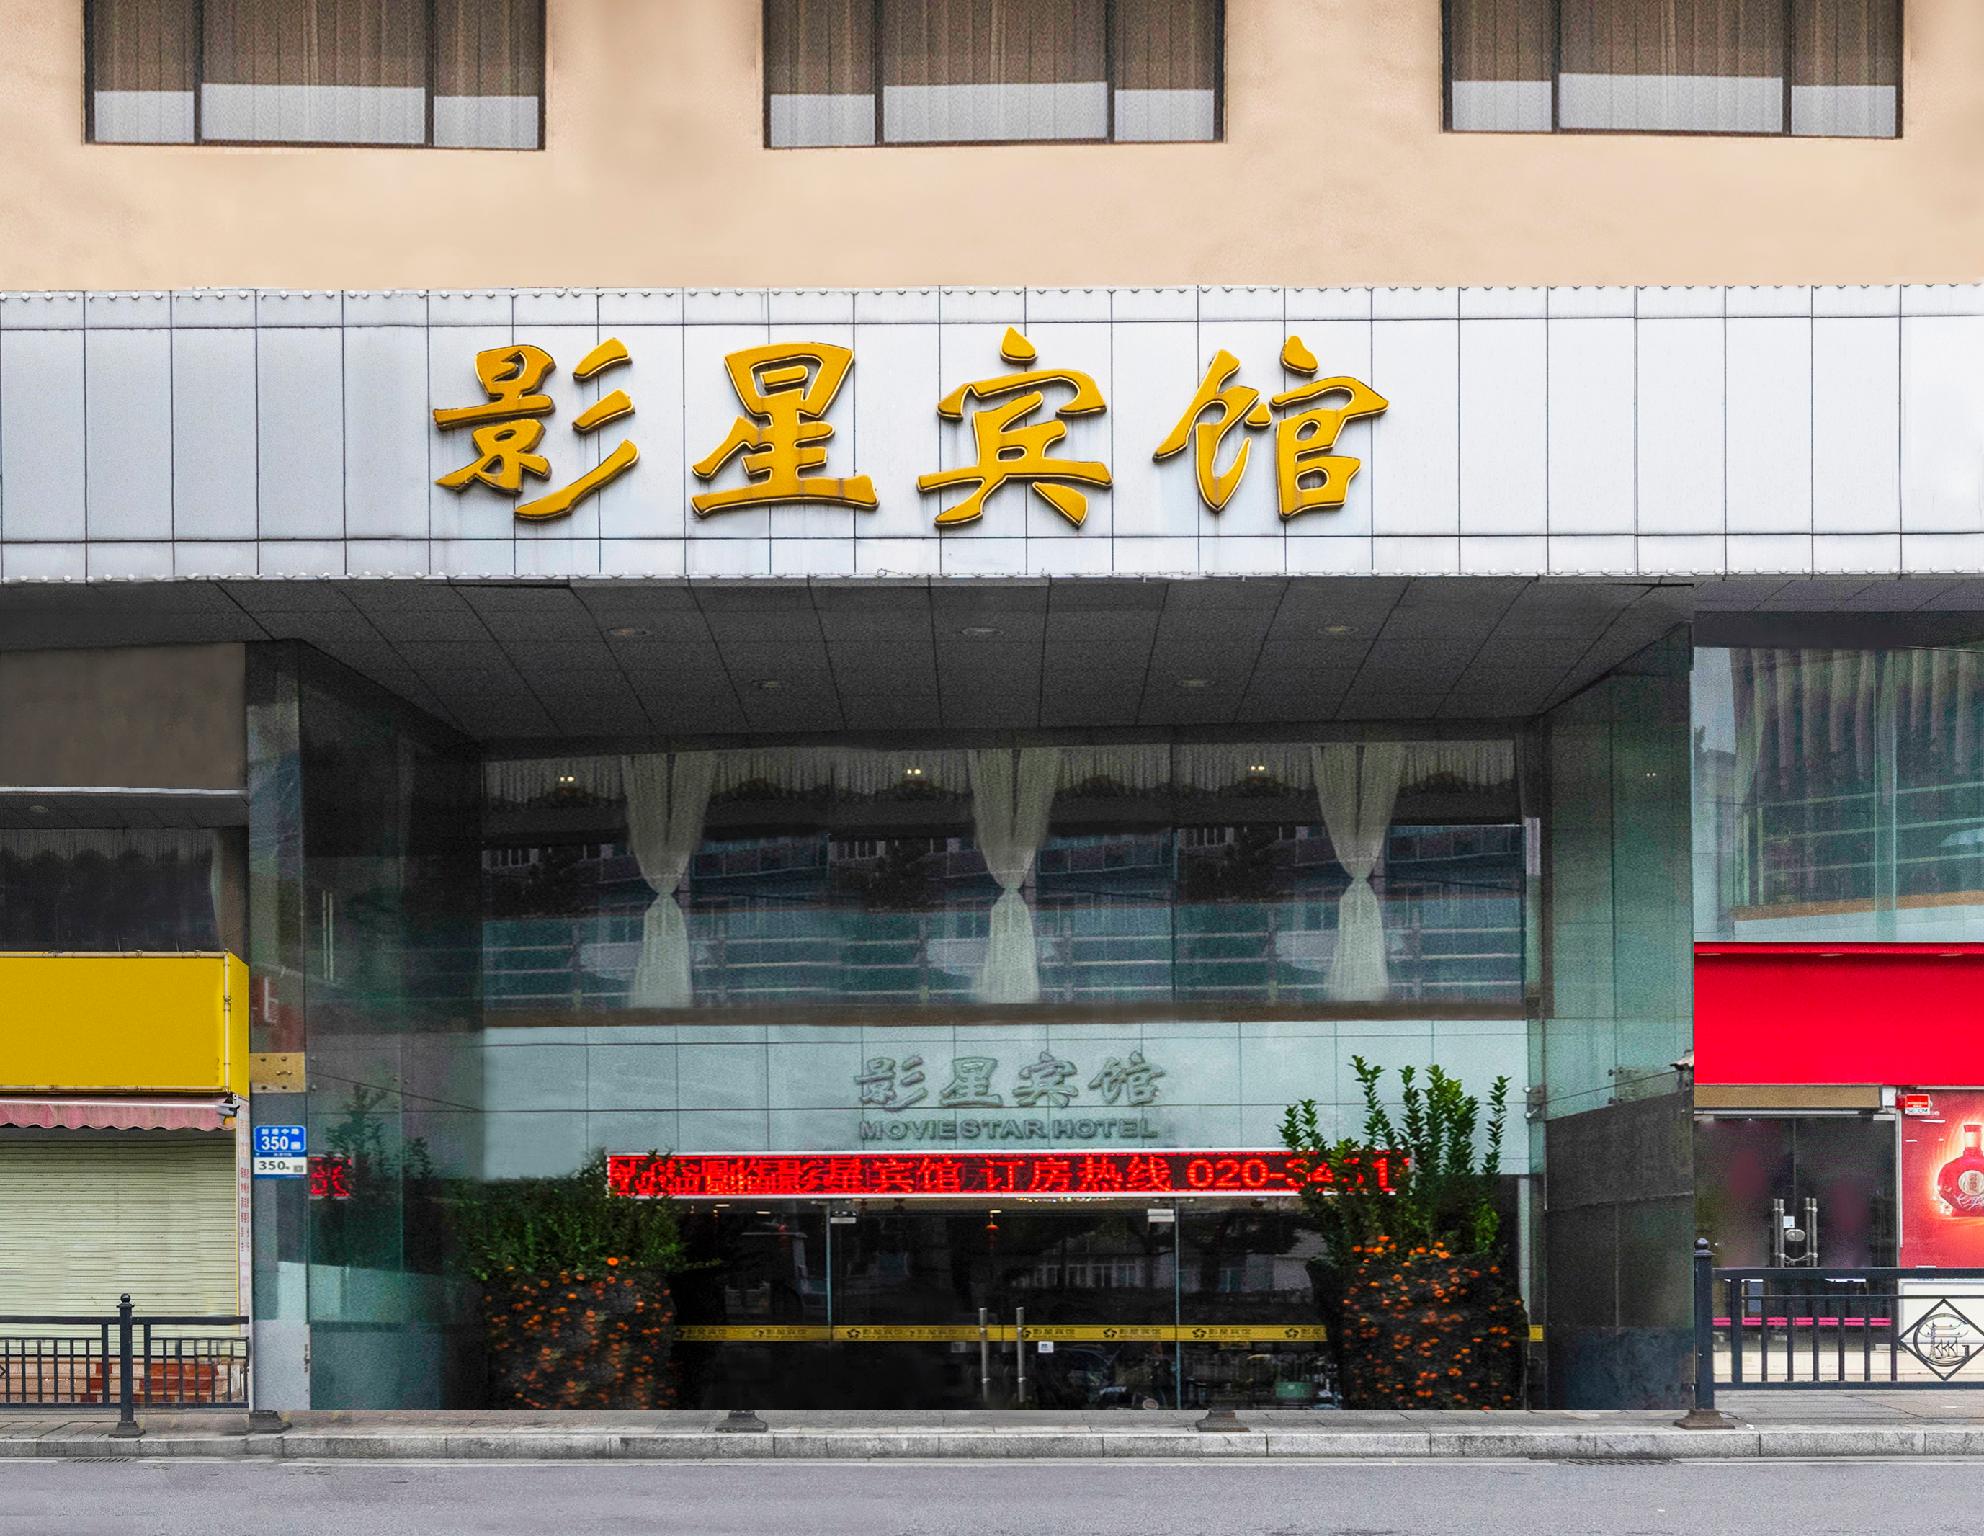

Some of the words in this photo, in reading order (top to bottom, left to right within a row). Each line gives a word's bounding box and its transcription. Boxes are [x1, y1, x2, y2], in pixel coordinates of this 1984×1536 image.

[434, 327, 1388, 527] 影星宾馆
[854, 1051, 1165, 1111] 影星宾馆
[860, 1118, 1049, 1140] MOVIESTAR
[1052, 1117, 1159, 1140] HOTEL
[980, 1155, 1172, 1191] 订房热线
